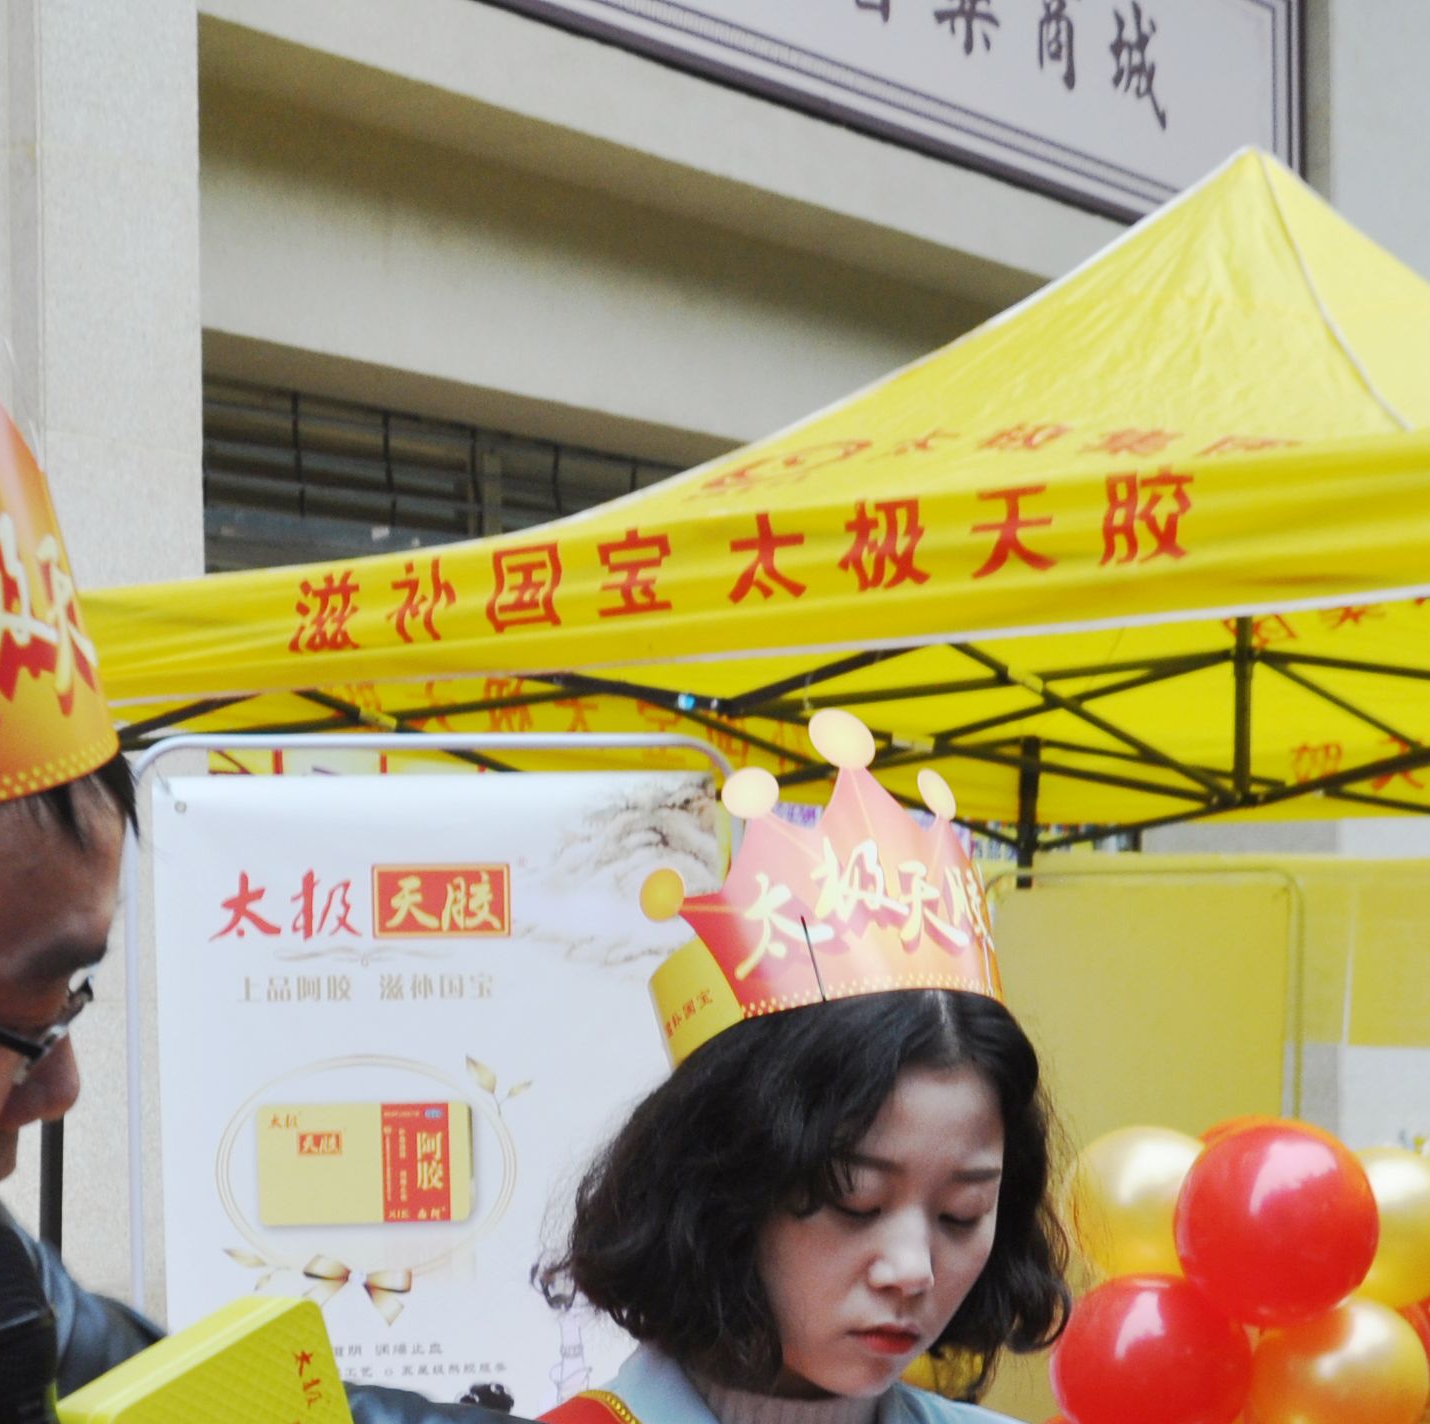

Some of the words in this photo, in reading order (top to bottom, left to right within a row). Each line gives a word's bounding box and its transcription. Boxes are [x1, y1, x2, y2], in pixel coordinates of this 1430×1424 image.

[237, 974, 353, 1003] 上品阿胶
[416, 1131, 444, 1191] 阿胶
